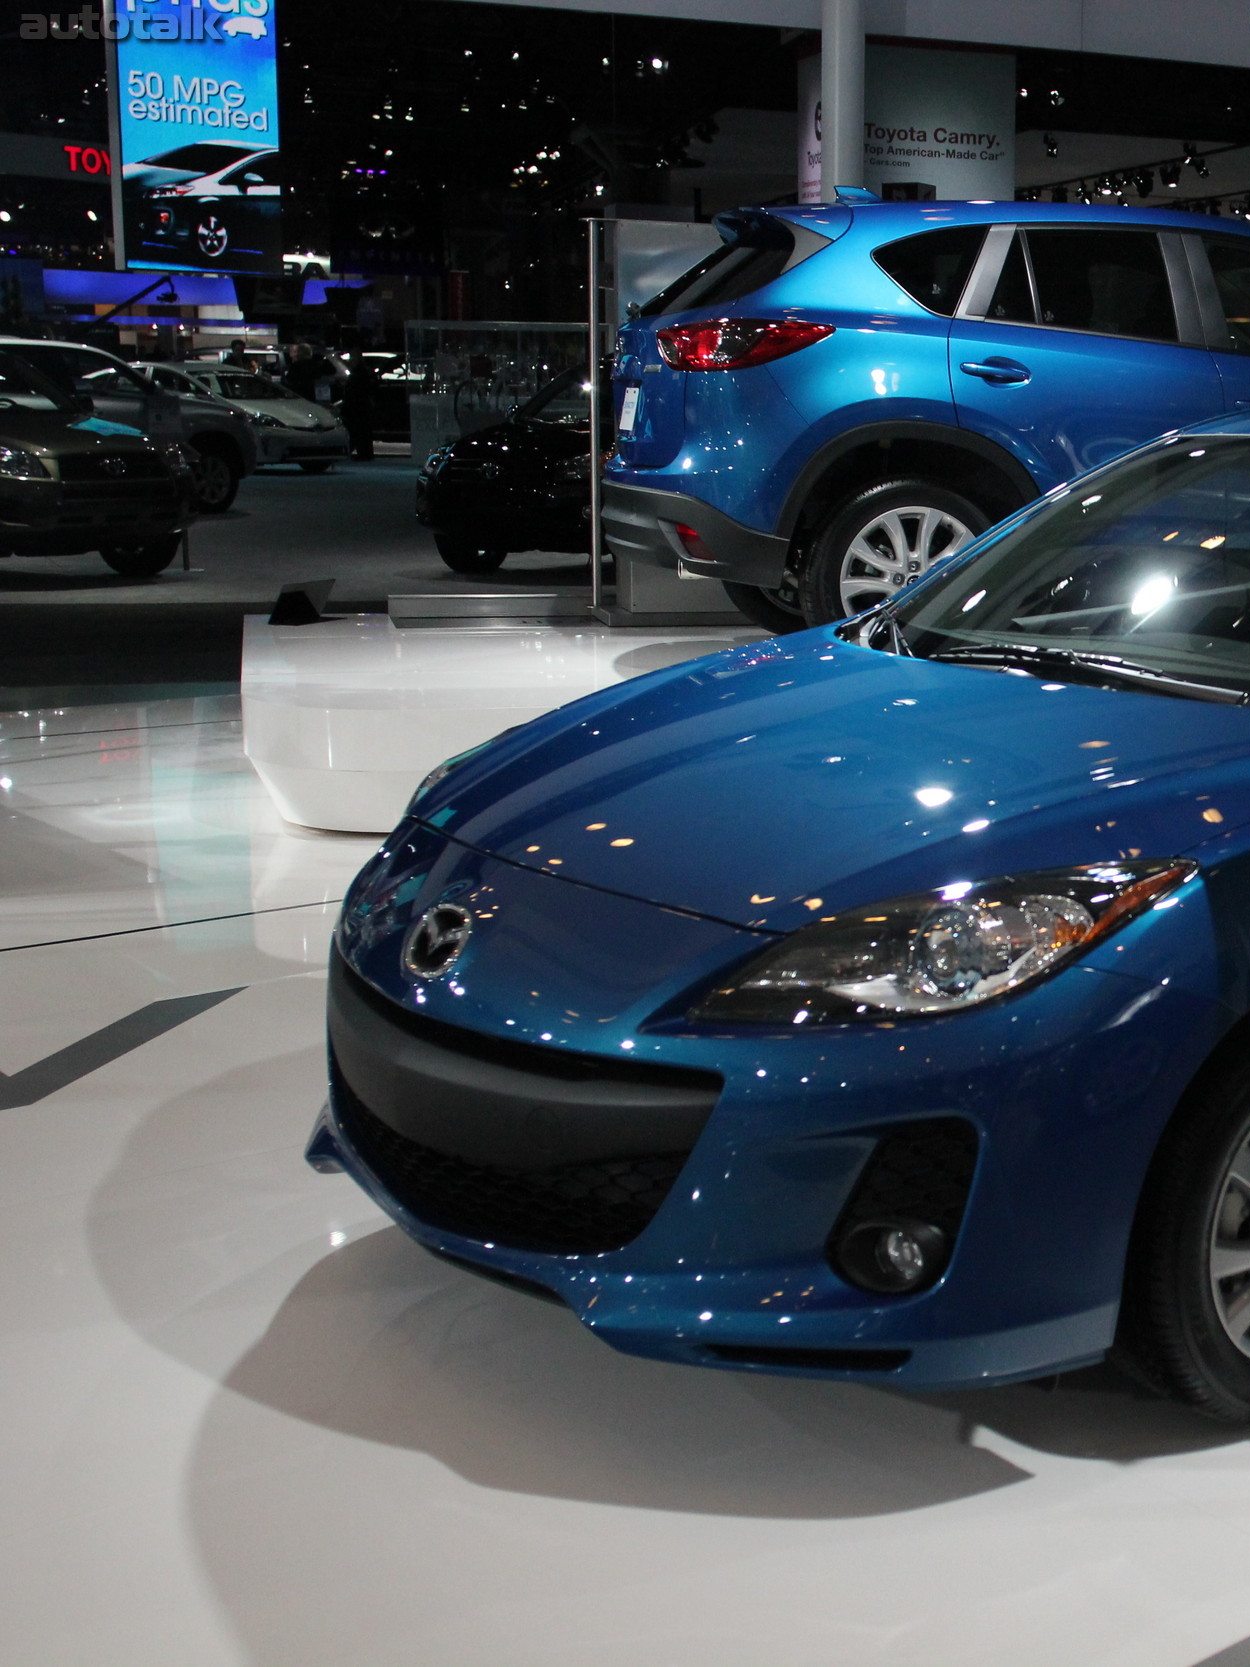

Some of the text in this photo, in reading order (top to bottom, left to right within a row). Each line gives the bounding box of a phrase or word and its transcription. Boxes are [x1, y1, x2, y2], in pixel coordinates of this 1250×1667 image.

[128, 70, 246, 107] 50 MPG
[128, 99, 269, 131] estimated
[864, 123, 1000, 149] Toyota Camry.
[886, 145, 977, 160] American-Made
